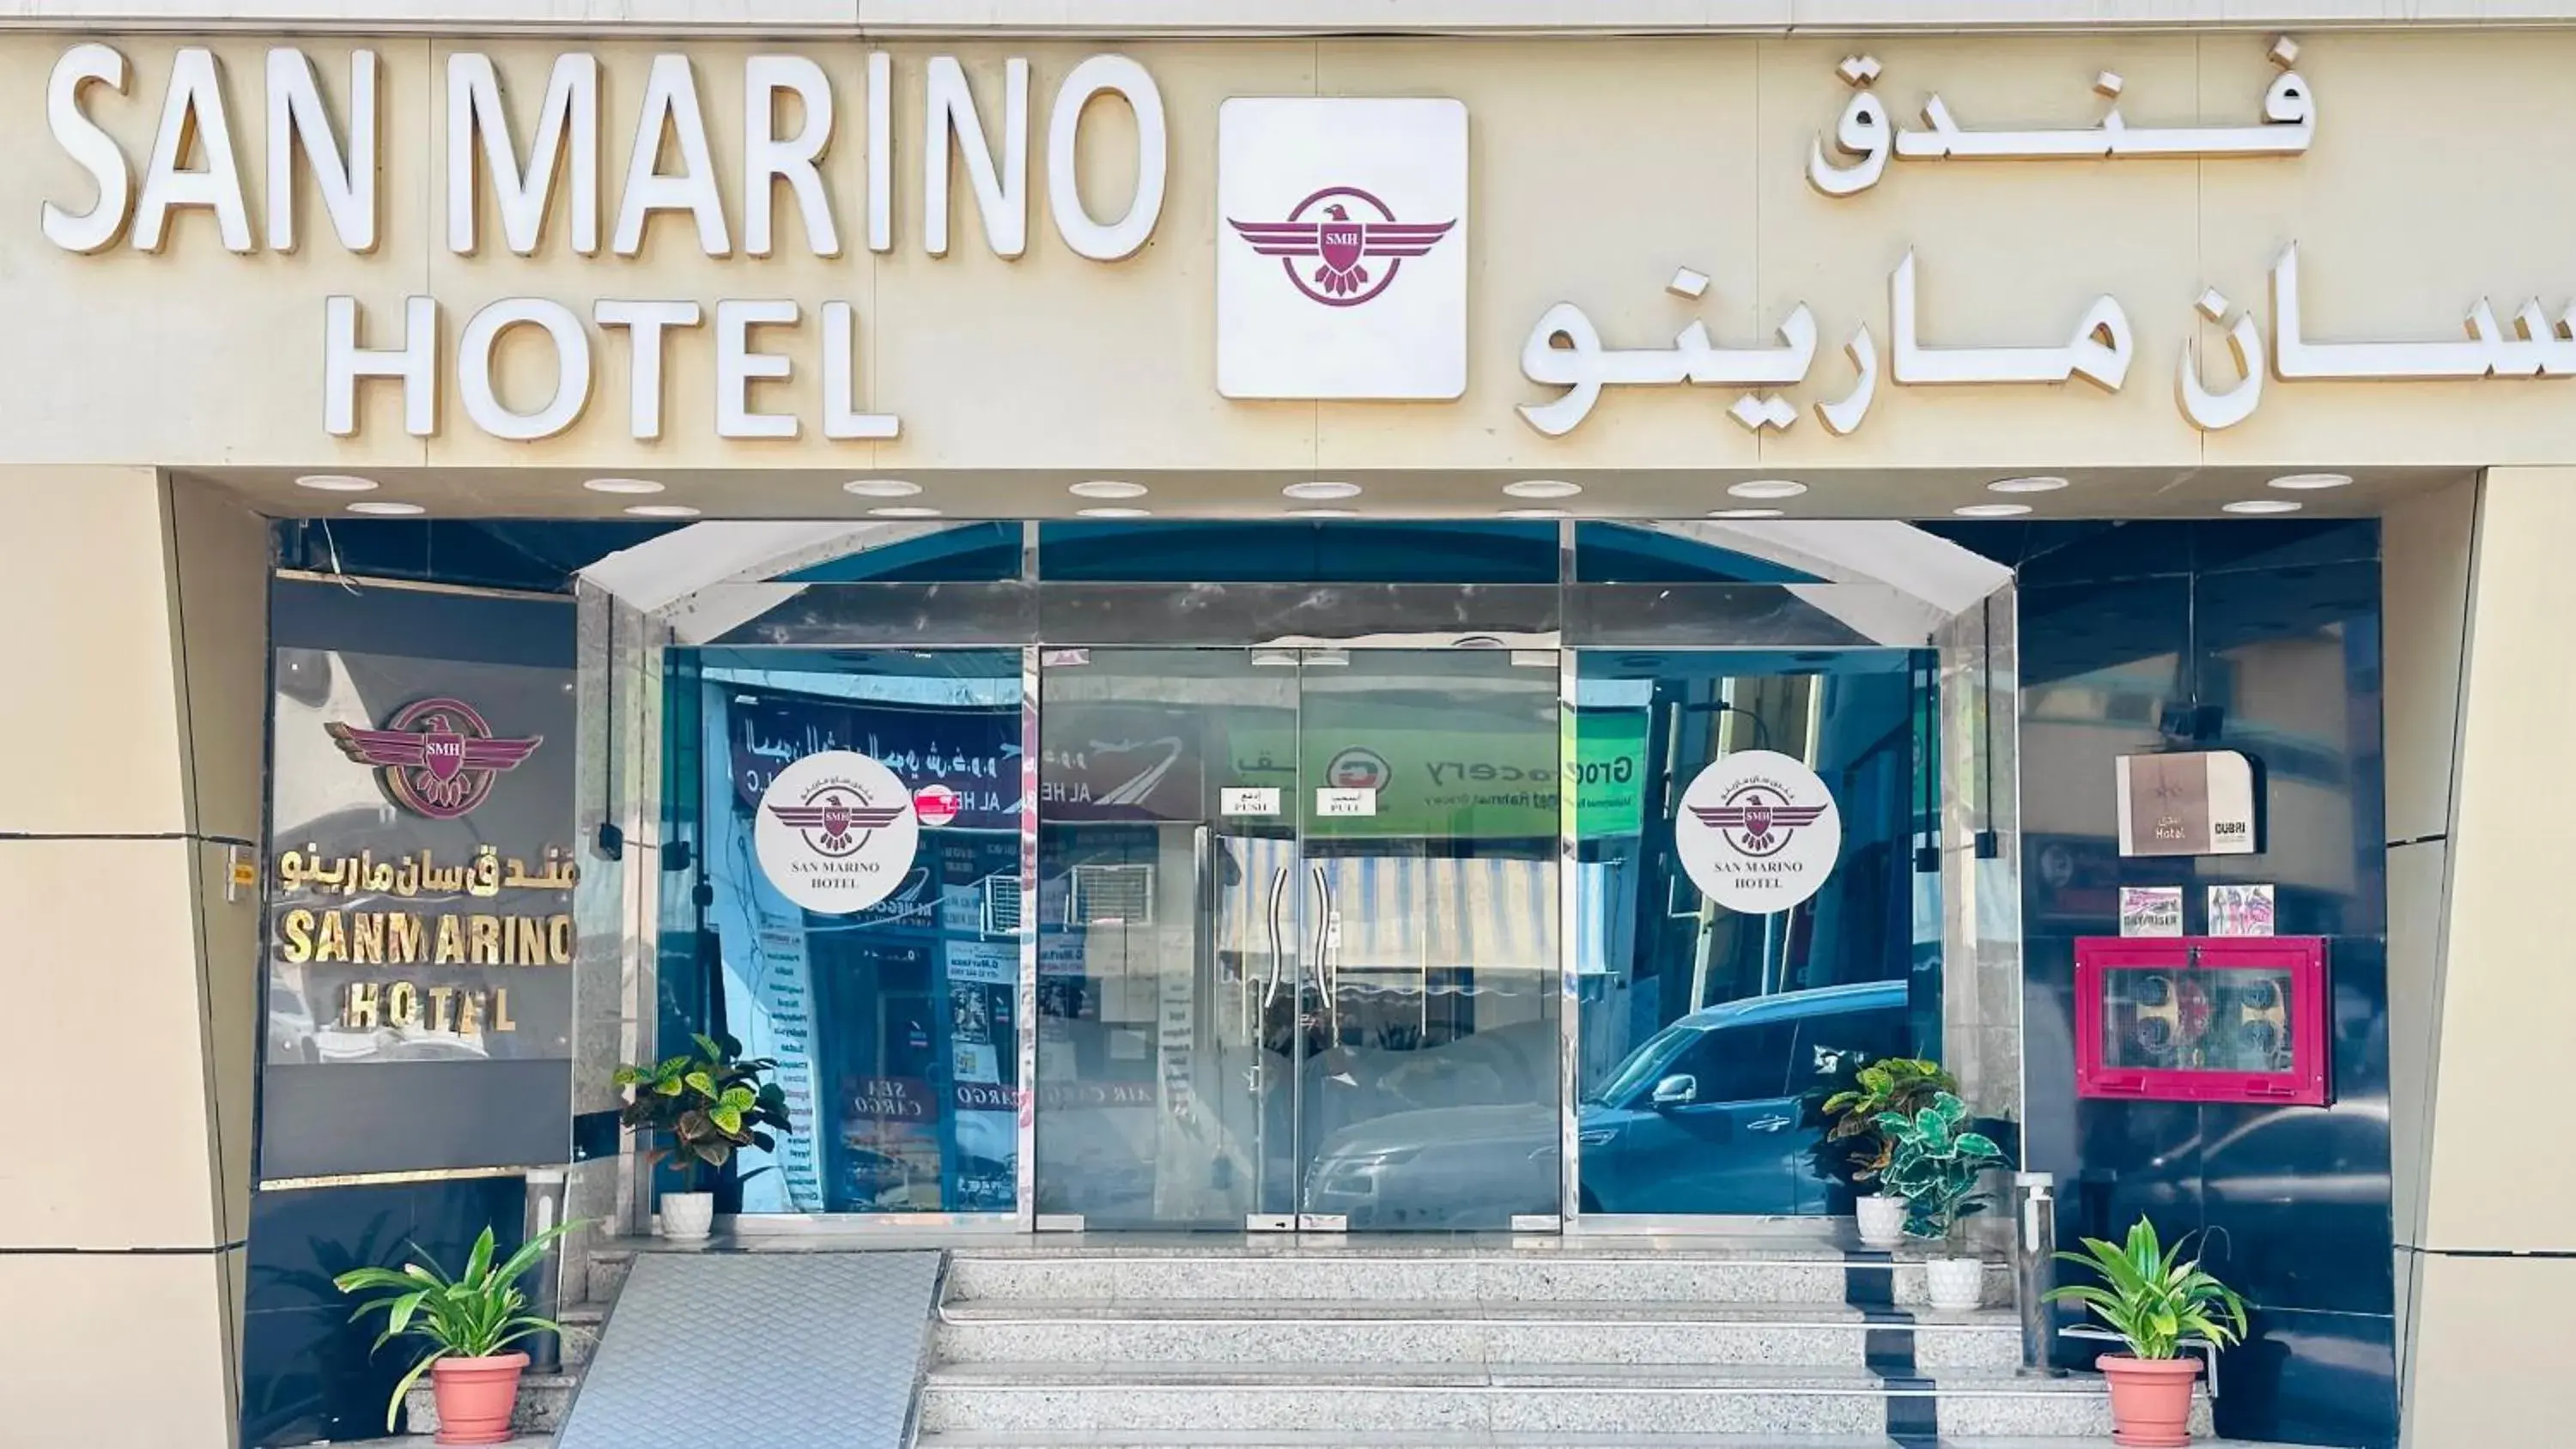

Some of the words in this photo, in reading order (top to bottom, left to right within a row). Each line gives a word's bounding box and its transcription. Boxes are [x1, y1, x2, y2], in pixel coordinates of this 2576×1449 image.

[1806, 37, 2317, 197] فندق
[40, 42, 380, 256] SAN
[446, 50, 1169, 262] MARINO
[1325, 233, 1358, 246] SMH
[1514, 243, 2134, 438] مارينو
[2175, 239, 2576, 432] سان
[323, 294, 902, 441] HOTEL
[426, 741, 462, 757] SMH
[1234, 803, 1267, 812] PUSH
[1330, 803, 1360, 813] PULL
[1746, 811, 1771, 822] SMH
[2155, 826, 2186, 840] Hotel
[2215, 822, 2246, 835] DUBAI
[279, 841, 394, 897] مارينو
[396, 848, 463, 897] سان
[466, 840, 580, 898] فندق
[791, 861, 818, 873] SAN
[823, 861, 880, 873] MARINO
[1714, 861, 1741, 873] SAN
[1744, 861, 1803, 873] MARINO
[811, 878, 860, 889] HOTEL
[1735, 878, 1783, 889] HOTEL
[343, 980, 516, 1039] HOTEL
